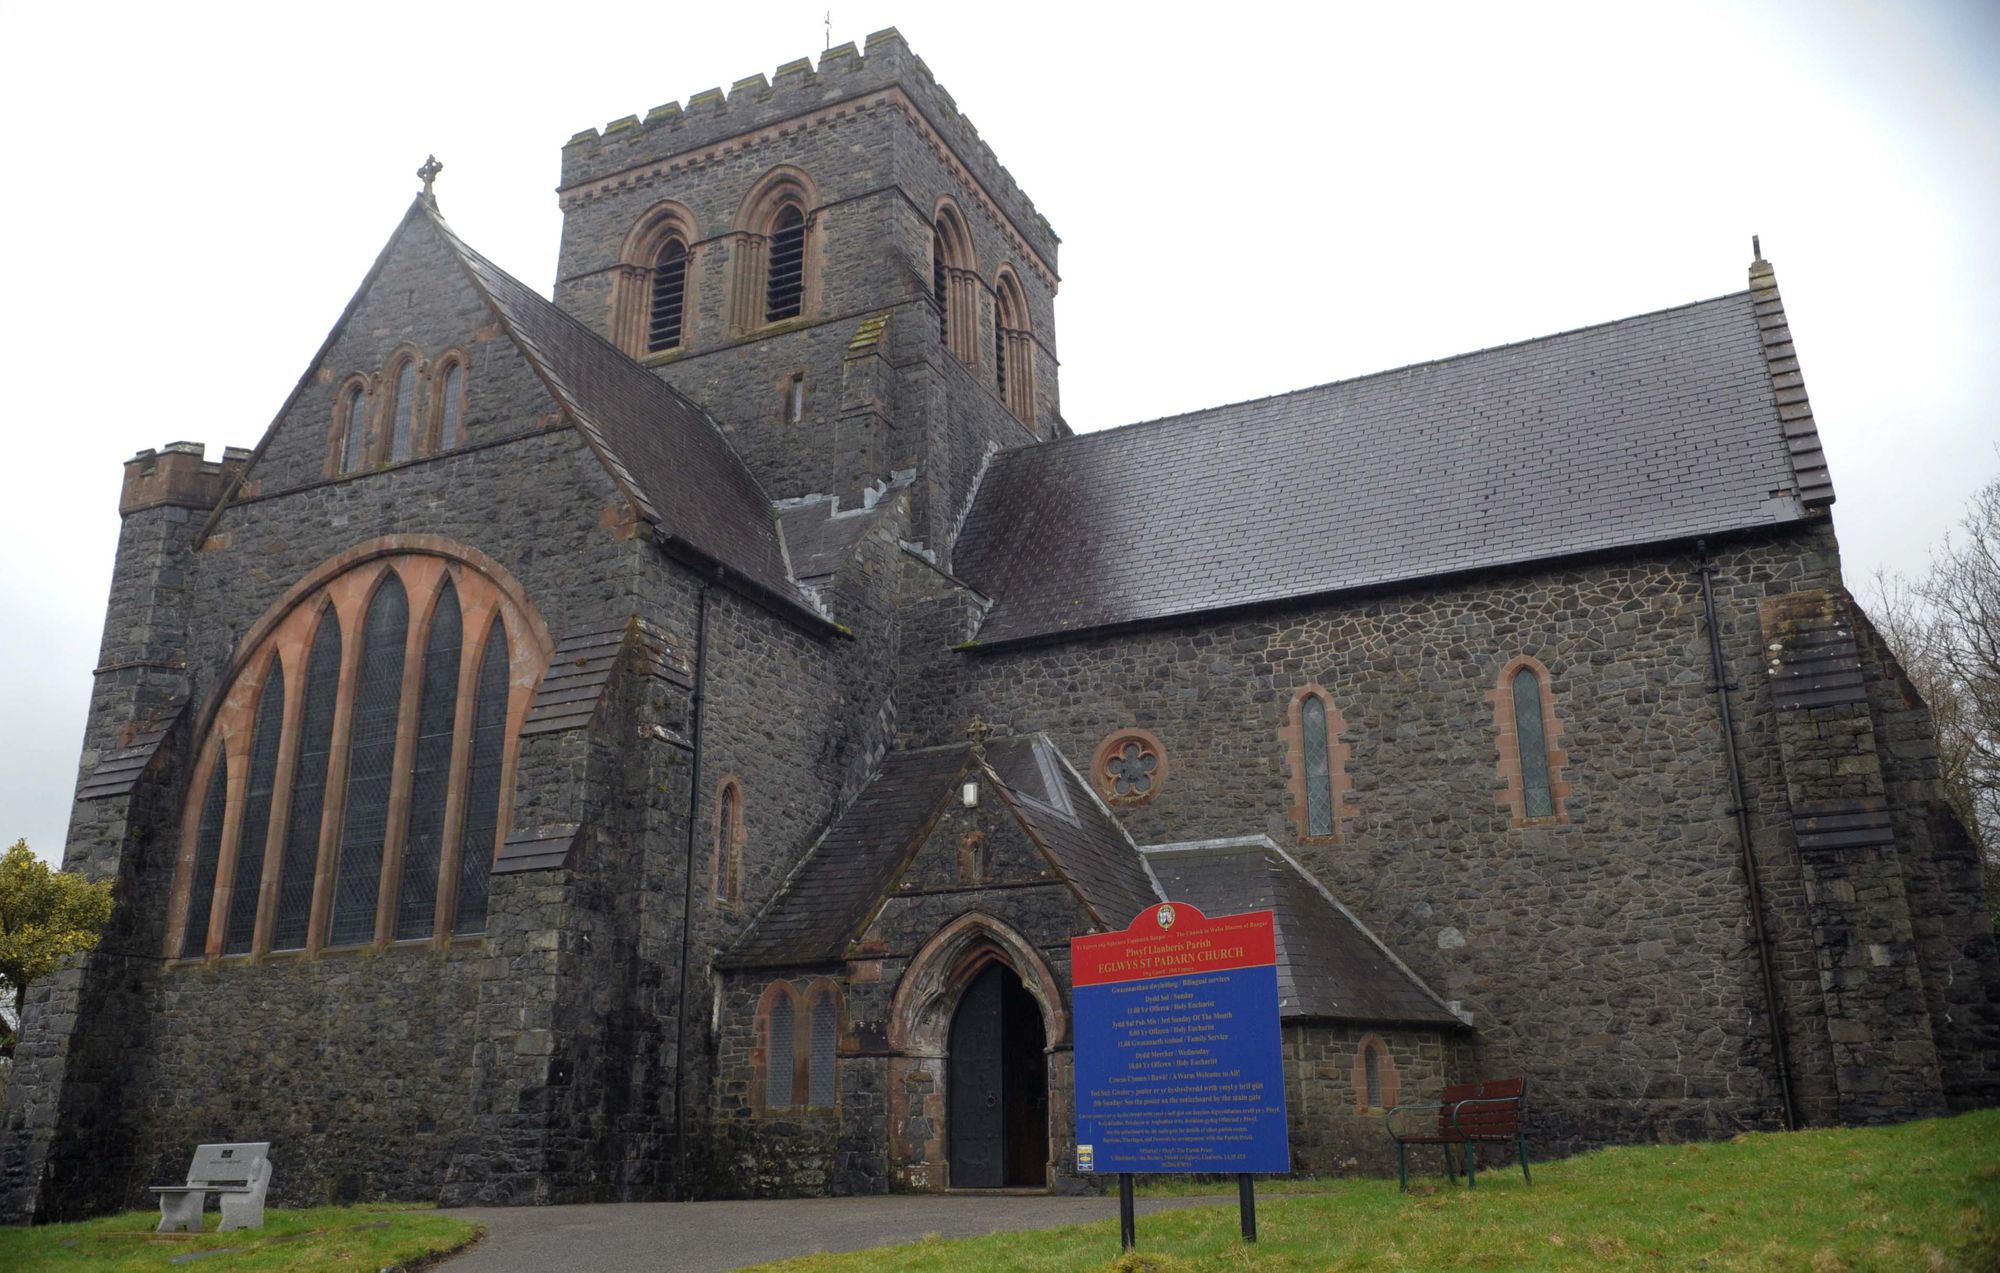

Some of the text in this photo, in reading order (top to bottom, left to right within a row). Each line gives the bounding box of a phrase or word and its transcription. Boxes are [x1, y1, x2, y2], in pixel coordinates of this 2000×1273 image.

[1126, 937, 1211, 959] Plwyf Llanberis Parish
[1098, 946, 1243, 973] EGLWYS ST PADARN CHURCH
[1173, 991, 1193, 1000] Sunday
